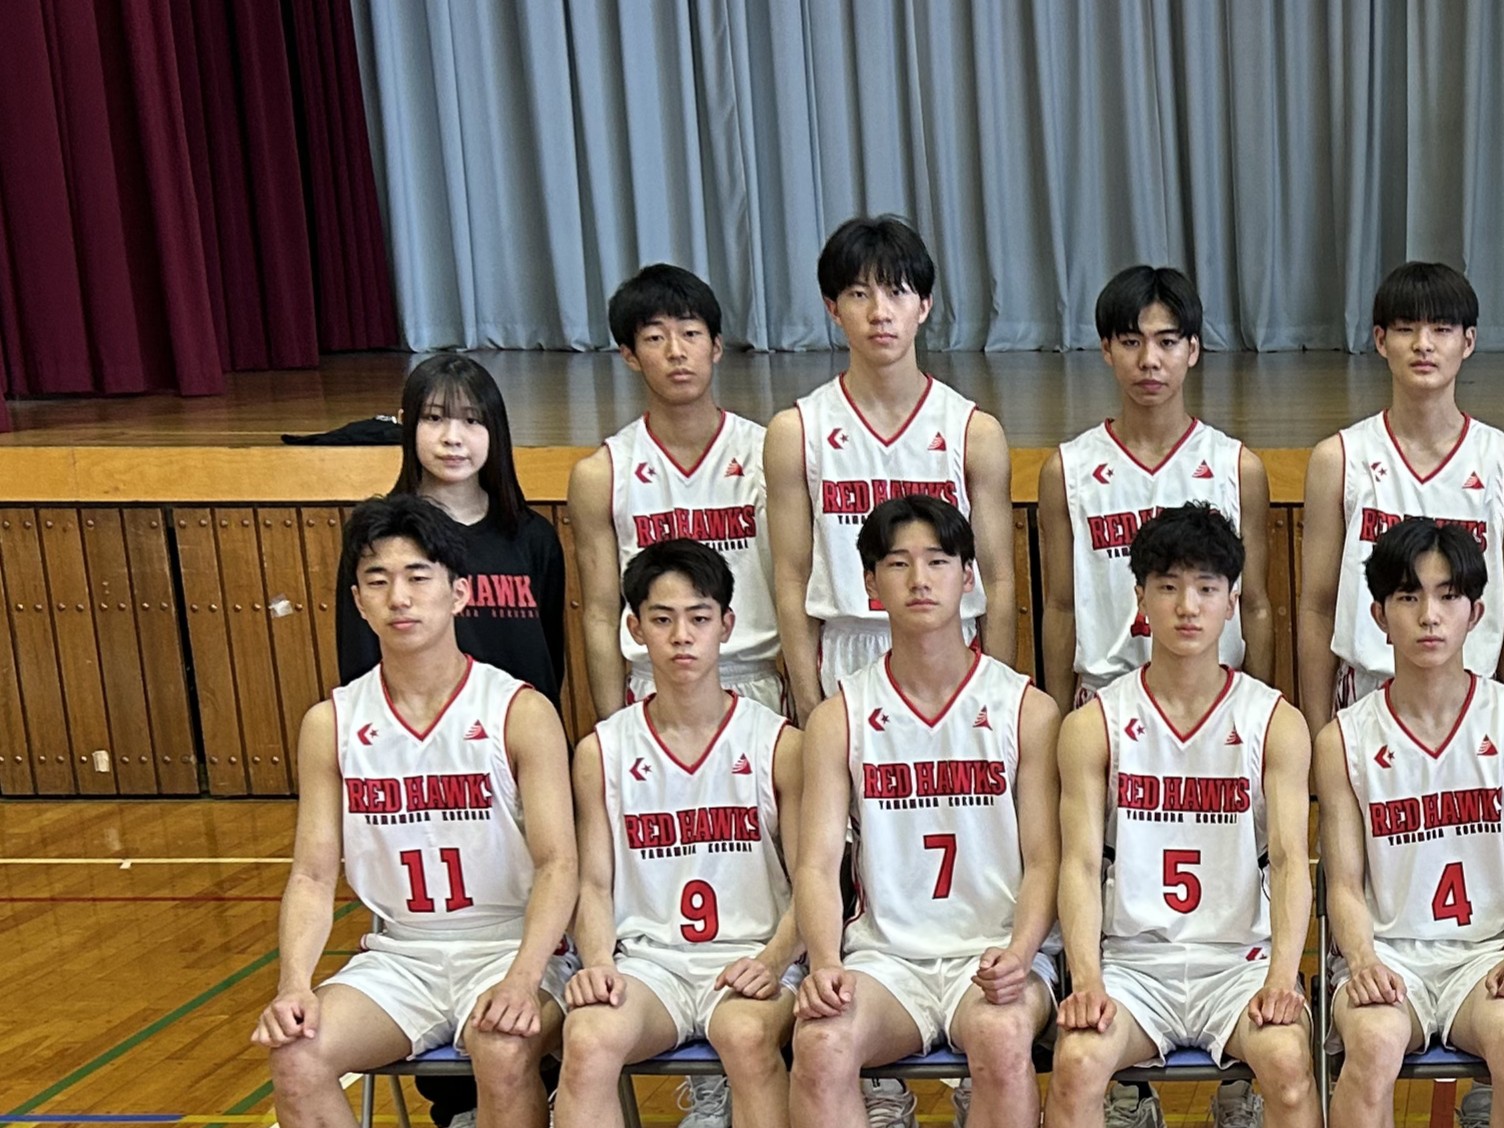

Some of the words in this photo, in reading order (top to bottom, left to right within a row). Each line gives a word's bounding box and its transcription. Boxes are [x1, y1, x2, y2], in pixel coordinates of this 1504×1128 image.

[822, 480, 871, 514] RED
[674, 505, 757, 541] HAWKS
[1087, 511, 1138, 550] RED
[466, 574, 537, 607] AWK
[344, 778, 402, 814] RED
[862, 762, 913, 799] RED
[913, 760, 1007, 797] HAWKS
[1117, 772, 1160, 811] RED
[1162, 776, 1251, 813] HAWKS
[624, 812, 677, 849] RED
[676, 806, 762, 845] HAWKS
[1369, 797, 1421, 837] RED
[399, 847, 475, 913] 11
[923, 833, 957, 900] 7
[1162, 849, 1202, 914] 5
[680, 879, 719, 943] 9
[1431, 861, 1473, 927] 4
